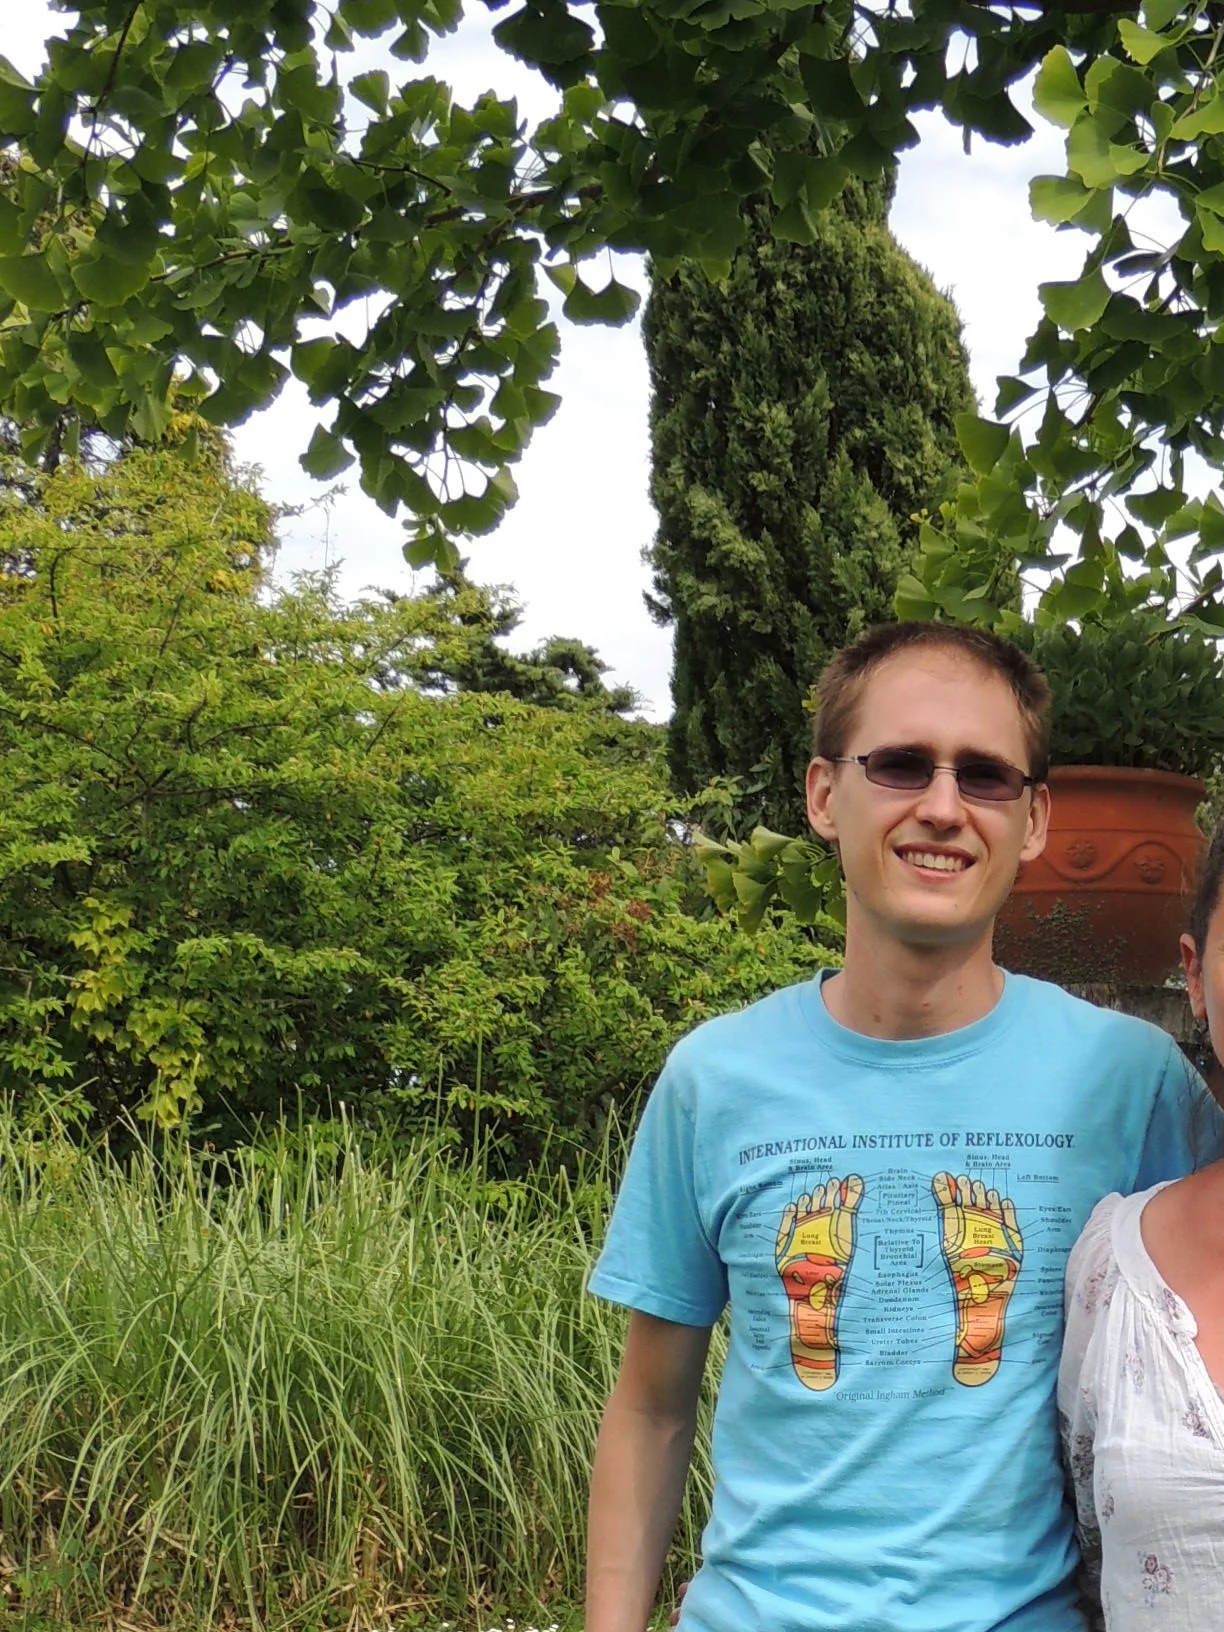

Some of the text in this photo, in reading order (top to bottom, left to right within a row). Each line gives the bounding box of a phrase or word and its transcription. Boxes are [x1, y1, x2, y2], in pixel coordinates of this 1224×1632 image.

[738, 1135, 847, 1166] INTERNATIONAL
[852, 1134, 934, 1149] INSTITUTE
[940, 1132, 960, 1147] OF
